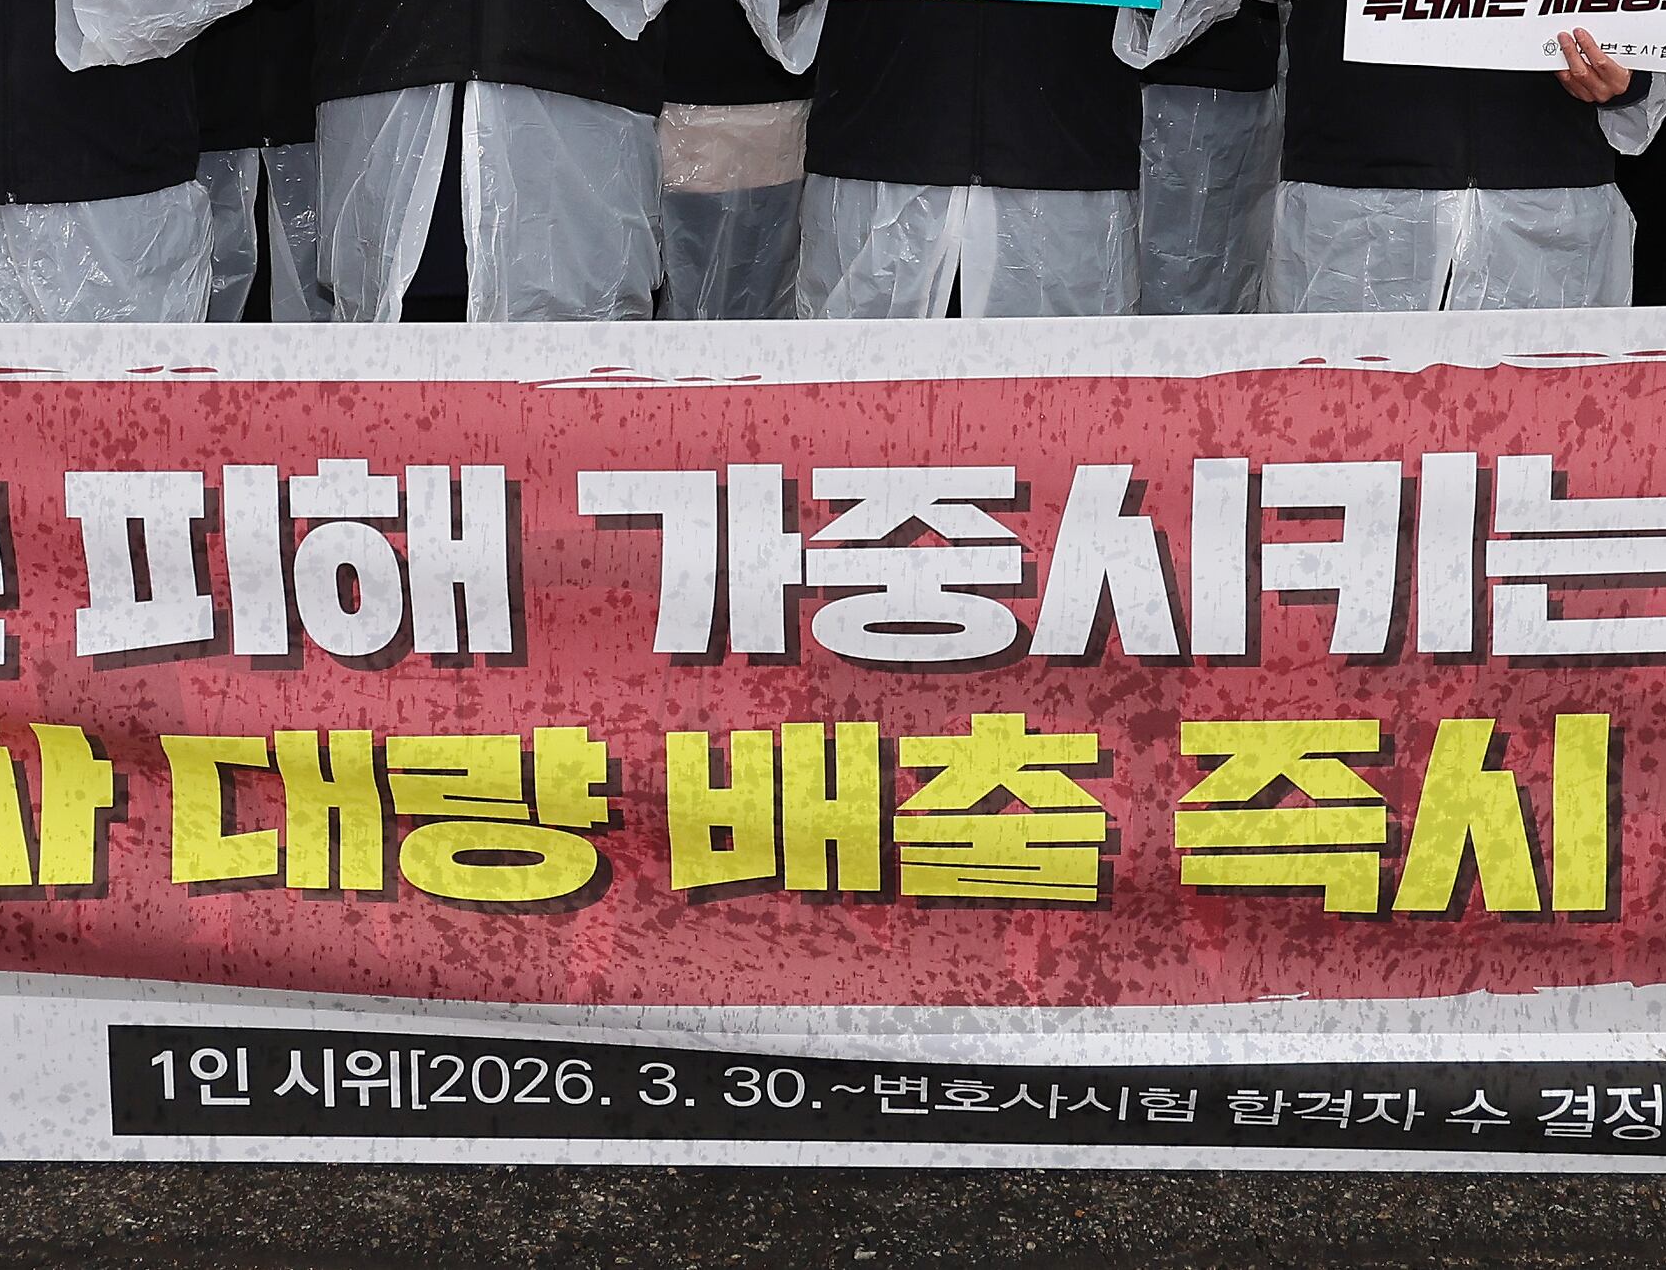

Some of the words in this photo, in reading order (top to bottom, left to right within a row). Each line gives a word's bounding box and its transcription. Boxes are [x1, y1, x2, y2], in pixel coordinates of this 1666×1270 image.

[60, 457, 514, 661] 피해
[163, 721, 611, 904] 대량
[664, 710, 1111, 905] 배출
[1173, 710, 1616, 916] 즉시
[150, 1047, 251, 1108] 1인
[274, 1046, 613, 1111] 시위[2026.
[637, 1061, 695, 1108] 3.
[1226, 1087, 1427, 1133] 합격자
[1443, 1088, 1513, 1133] 수
